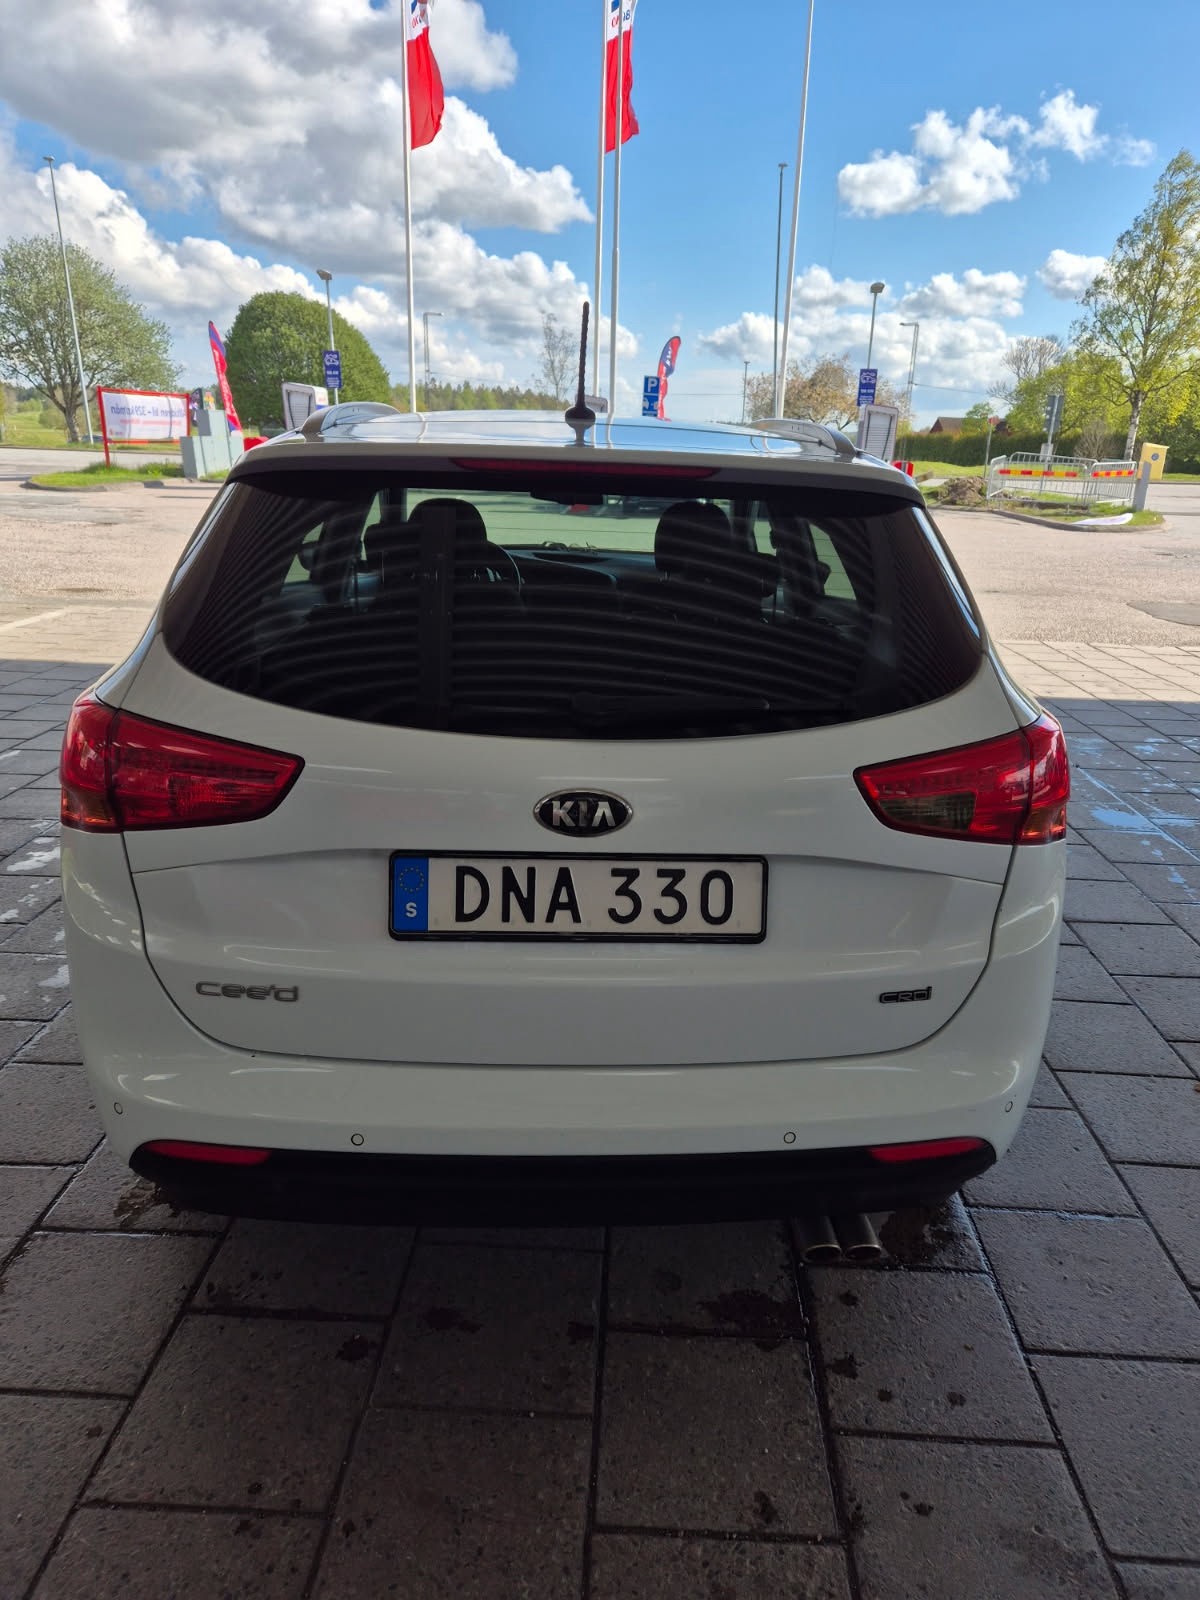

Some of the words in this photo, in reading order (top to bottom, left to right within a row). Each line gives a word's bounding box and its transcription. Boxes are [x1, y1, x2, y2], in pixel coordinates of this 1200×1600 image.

[648, 378, 657, 392] P
[551, 800, 616, 827] KIA
[454, 866, 582, 924] DNA
[607, 868, 734, 925] 330
[405, 903, 417, 918] S
